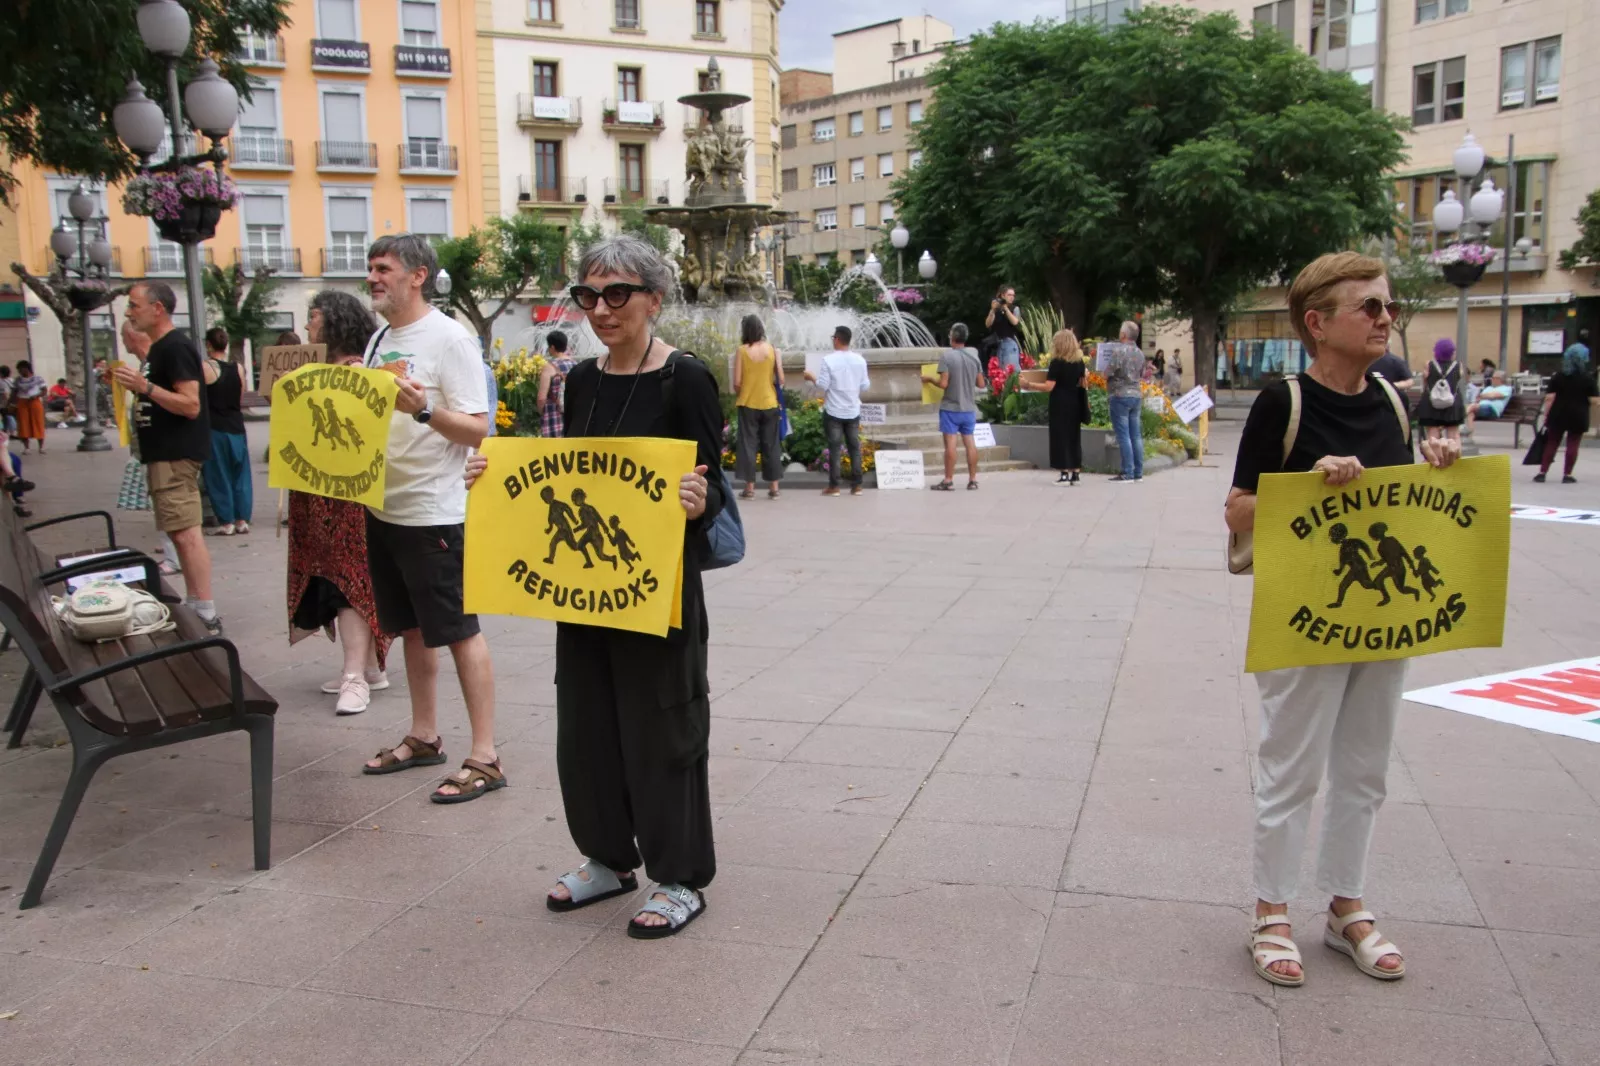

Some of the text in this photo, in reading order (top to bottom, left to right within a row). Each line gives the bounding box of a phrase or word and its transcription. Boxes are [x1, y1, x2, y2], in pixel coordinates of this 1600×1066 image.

[266, 349, 318, 372] ACOGIDA
[282, 366, 388, 419] REFUGIADOS
[279, 440, 385, 499] BIENVENIDOS
[503, 450, 667, 503] BIENVENIDXS
[1290, 482, 1478, 540] BIENVENIDAS
[507, 559, 659, 614] REFUGIADXS
[1288, 592, 1467, 650] REFUGIADAS
